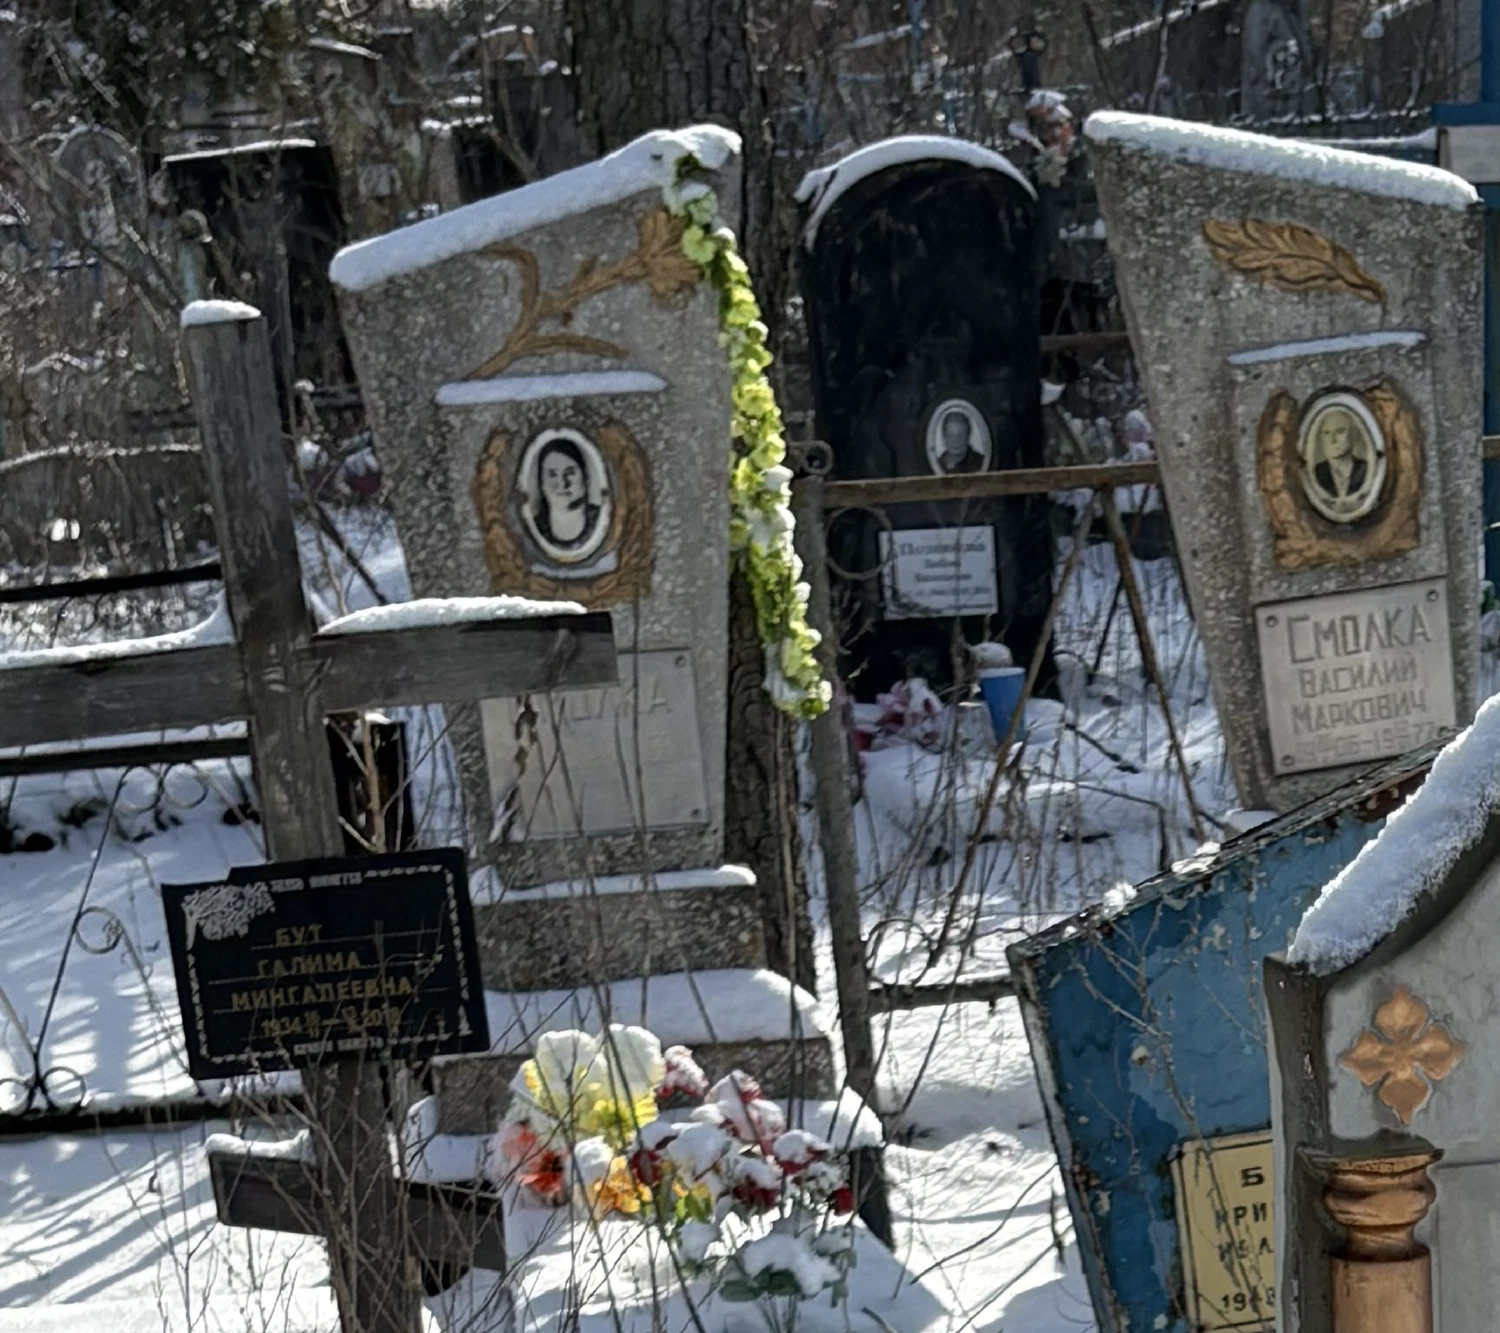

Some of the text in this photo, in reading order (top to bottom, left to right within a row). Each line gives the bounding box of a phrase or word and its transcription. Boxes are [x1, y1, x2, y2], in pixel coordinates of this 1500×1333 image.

[1287, 604, 1432, 664] СМОЛКА
[1300, 651, 1418, 699] ВАСИЛИЙ
[1291, 689, 1427, 734] МАРКОВИЧ
[275, 924, 323, 948] БУТ
[256, 951, 362, 979] ГАЛИМА
